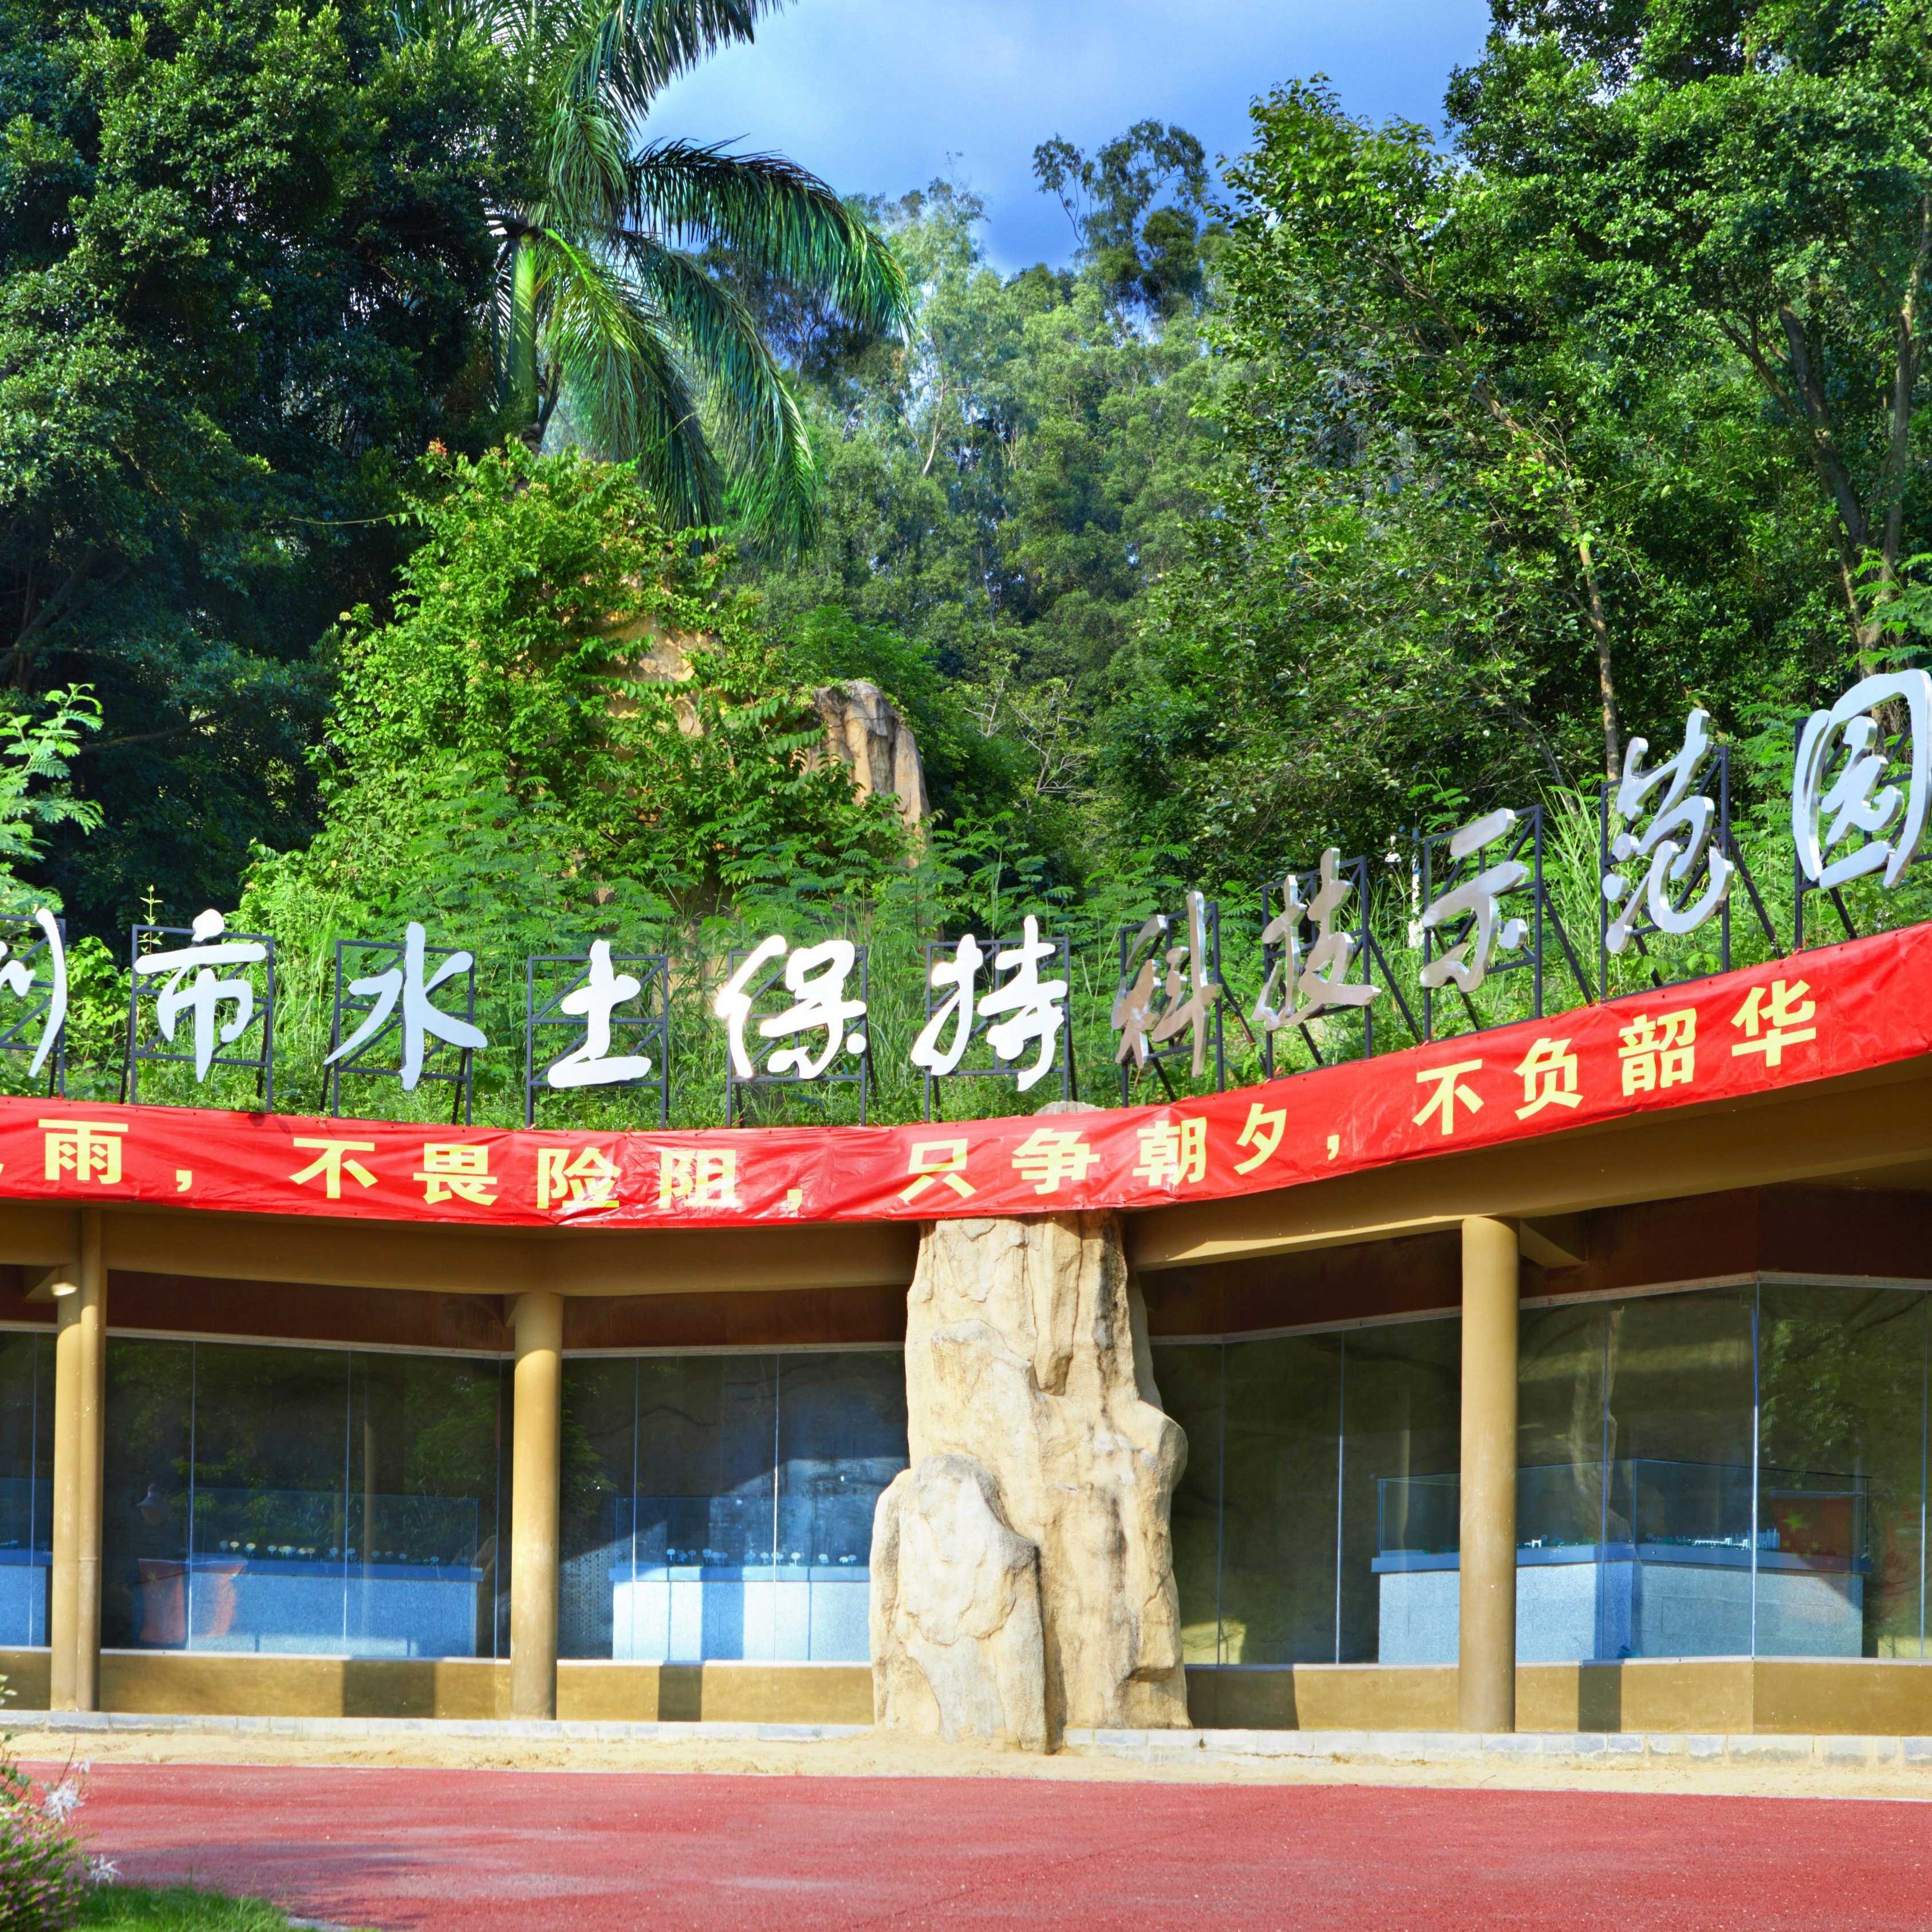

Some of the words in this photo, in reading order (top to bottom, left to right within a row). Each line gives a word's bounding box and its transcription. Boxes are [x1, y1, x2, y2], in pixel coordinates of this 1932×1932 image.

[0, 979, 1817, 1212] 雨，不畏险阻，只争朝夕，不负韶华
